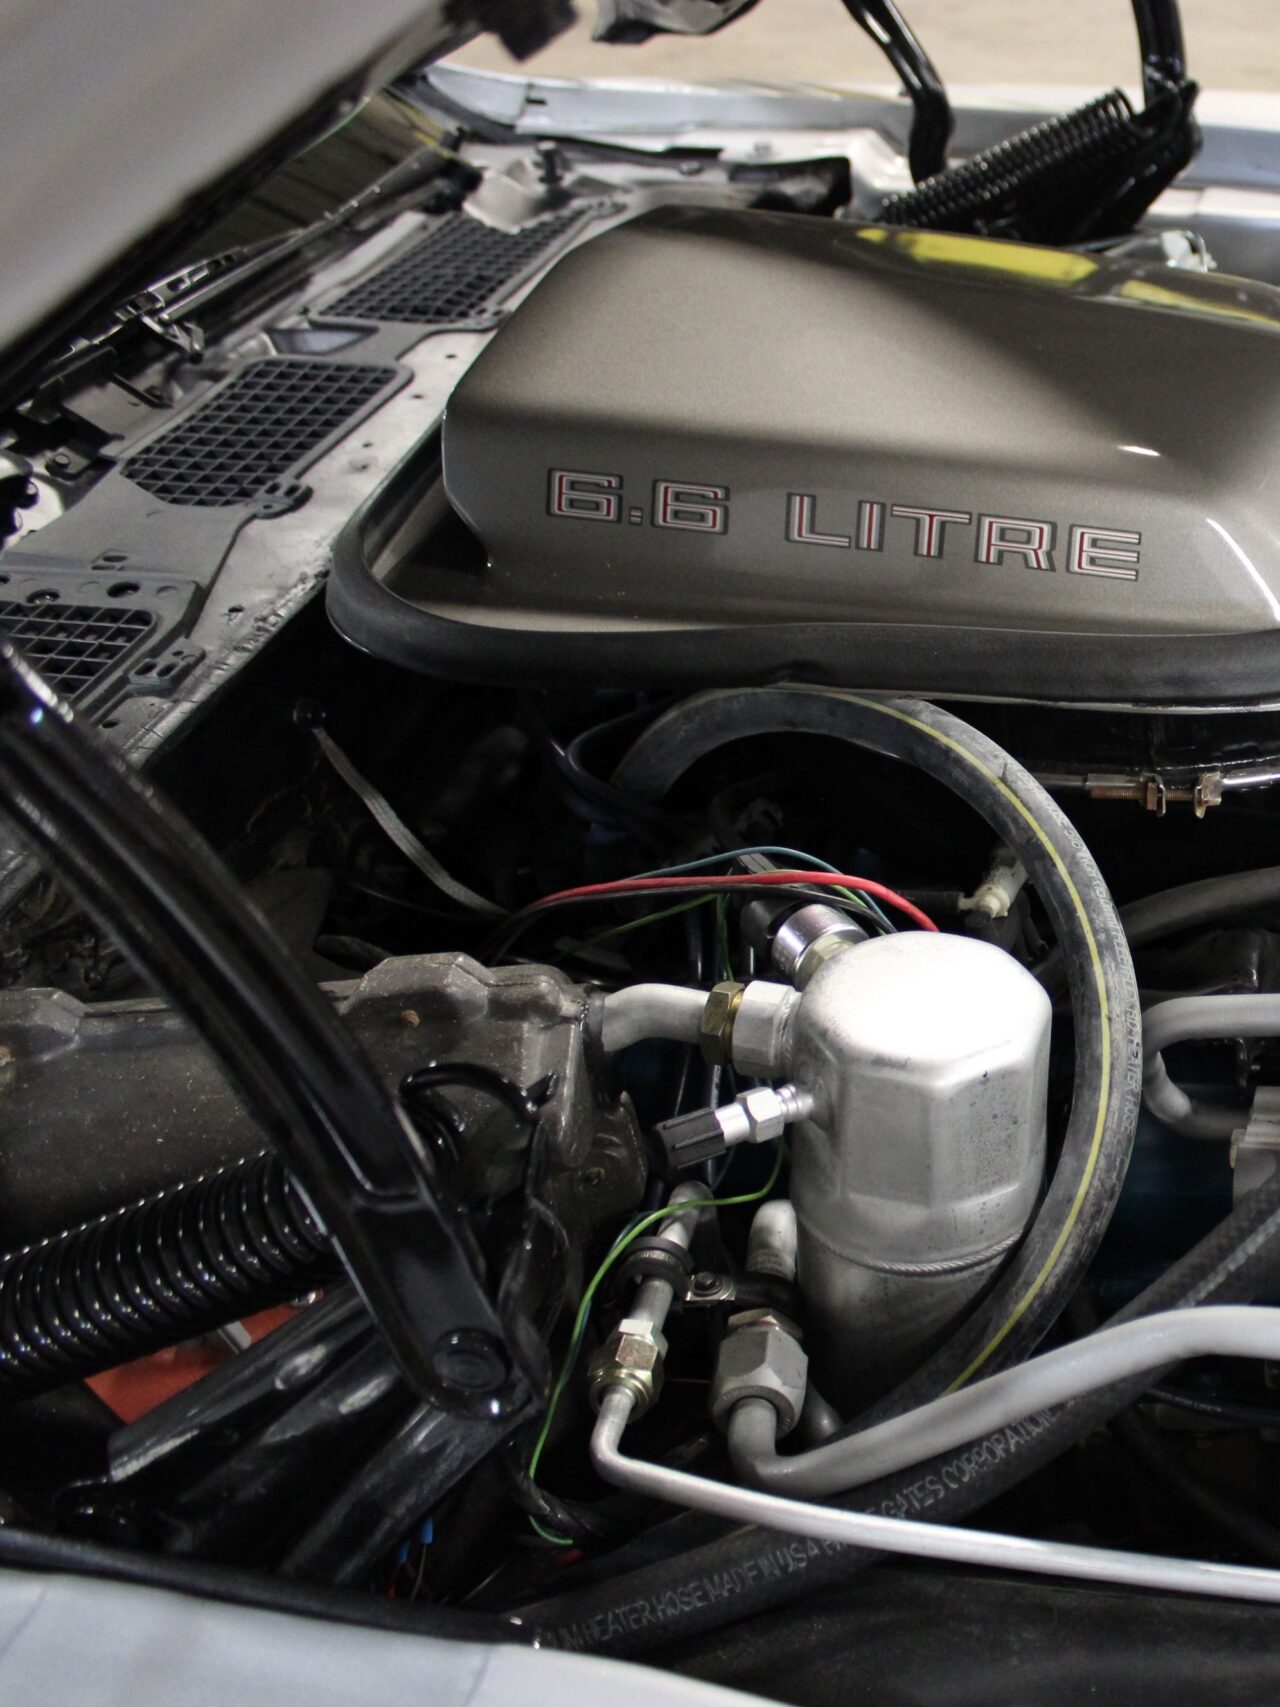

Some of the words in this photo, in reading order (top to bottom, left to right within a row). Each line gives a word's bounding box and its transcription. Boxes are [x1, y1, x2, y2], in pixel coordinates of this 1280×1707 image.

[547, 467, 730, 535] 6.6
[785, 491, 1142, 582] LITRE
[1126, 1035, 1140, 1092] HEATER
[1120, 1095, 1138, 1135] HOSE
[583, 1600, 656, 1644] HEATER
[653, 1580, 706, 1620] HOSE
[704, 1561, 761, 1600] MADE
[757, 1552, 781, 1580] IN
[882, 1477, 945, 1517] GATES
[943, 1407, 1055, 1487] CORPORATION
